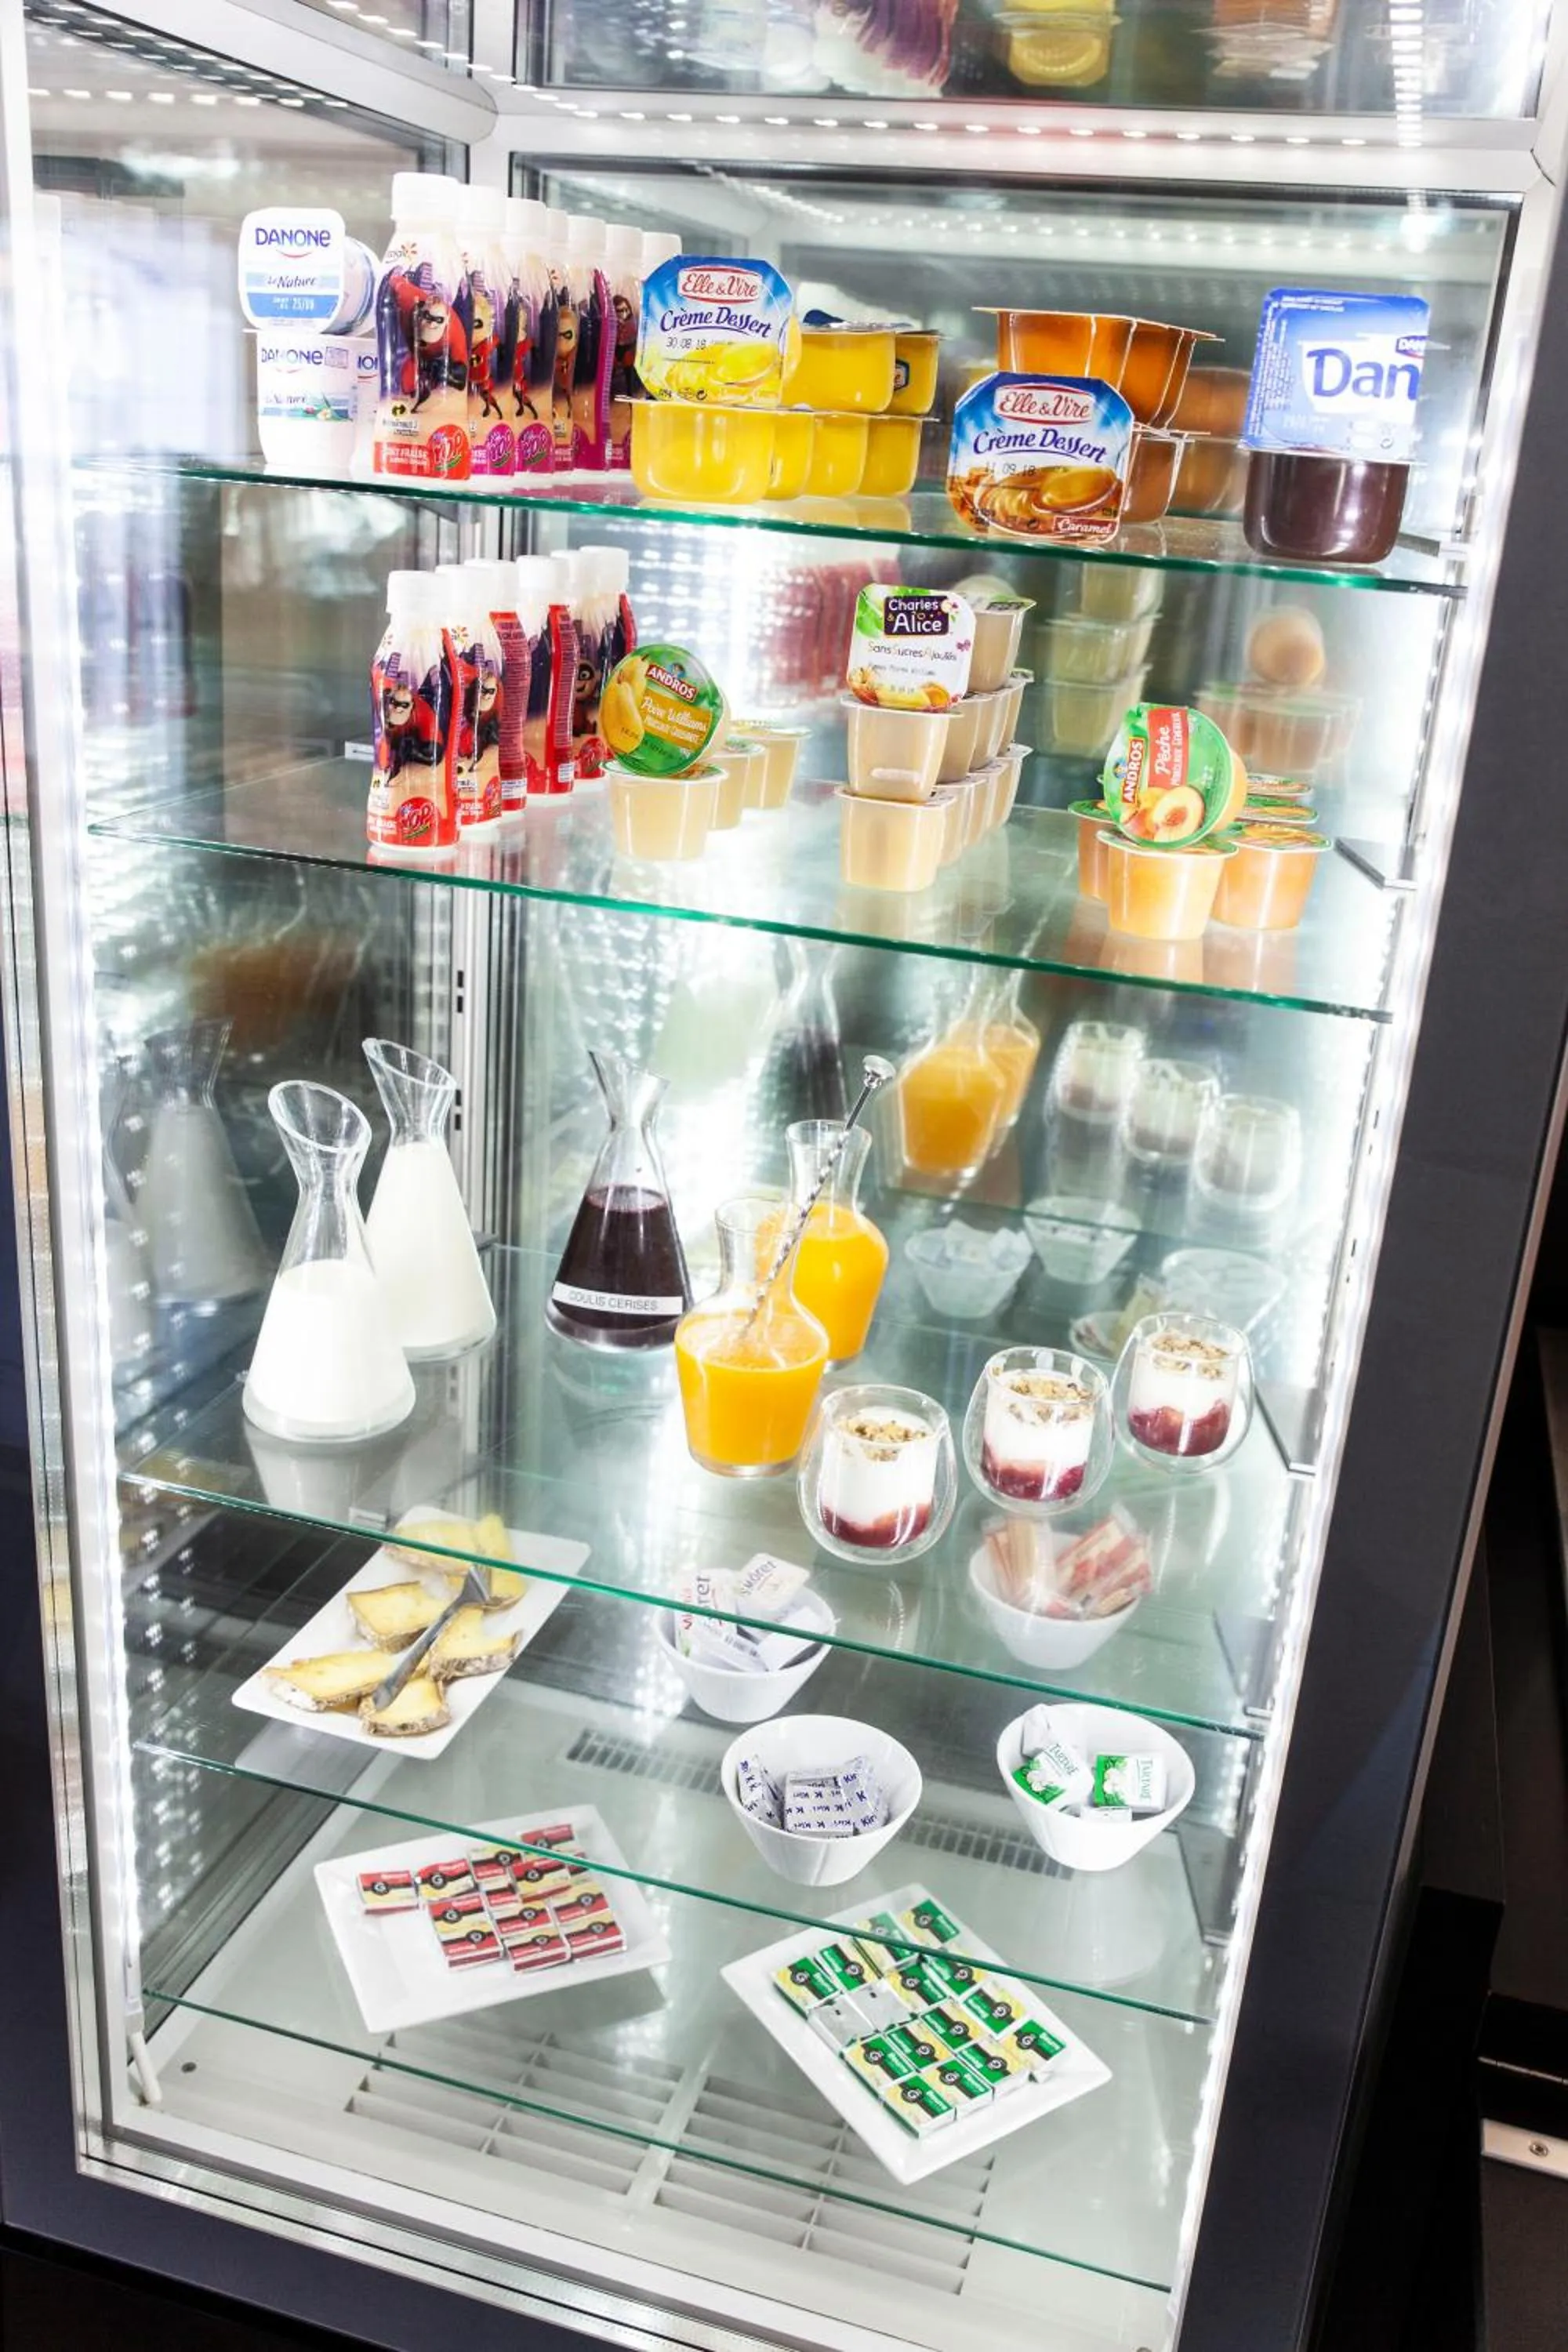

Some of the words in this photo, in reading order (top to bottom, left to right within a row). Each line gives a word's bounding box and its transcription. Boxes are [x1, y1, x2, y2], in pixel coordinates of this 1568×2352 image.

[681, 273, 714, 294] Elle
[717, 285, 725, 295] &
[725, 274, 758, 297] Vire
[659, 308, 713, 332] Crème
[716, 307, 772, 338] Dessert
[1306, 347, 1421, 401] Dan
[998, 390, 1038, 415] Elle
[1039, 403, 1049, 415] &
[1049, 394, 1091, 419] Vire
[973, 428, 1036, 456] Crème
[1039, 427, 1108, 464] Dessert
[1058, 517, 1112, 535] Caramel
[887, 598, 938, 612] Charles
[892, 611, 942, 633] Alice
[648, 666, 696, 699] ANDROS
[1154, 726, 1172, 775] Pêche
[1123, 741, 1144, 803] ANDROS
[569, 1291, 605, 1307] COULIS
[608, 1298, 659, 1312] CERISES
